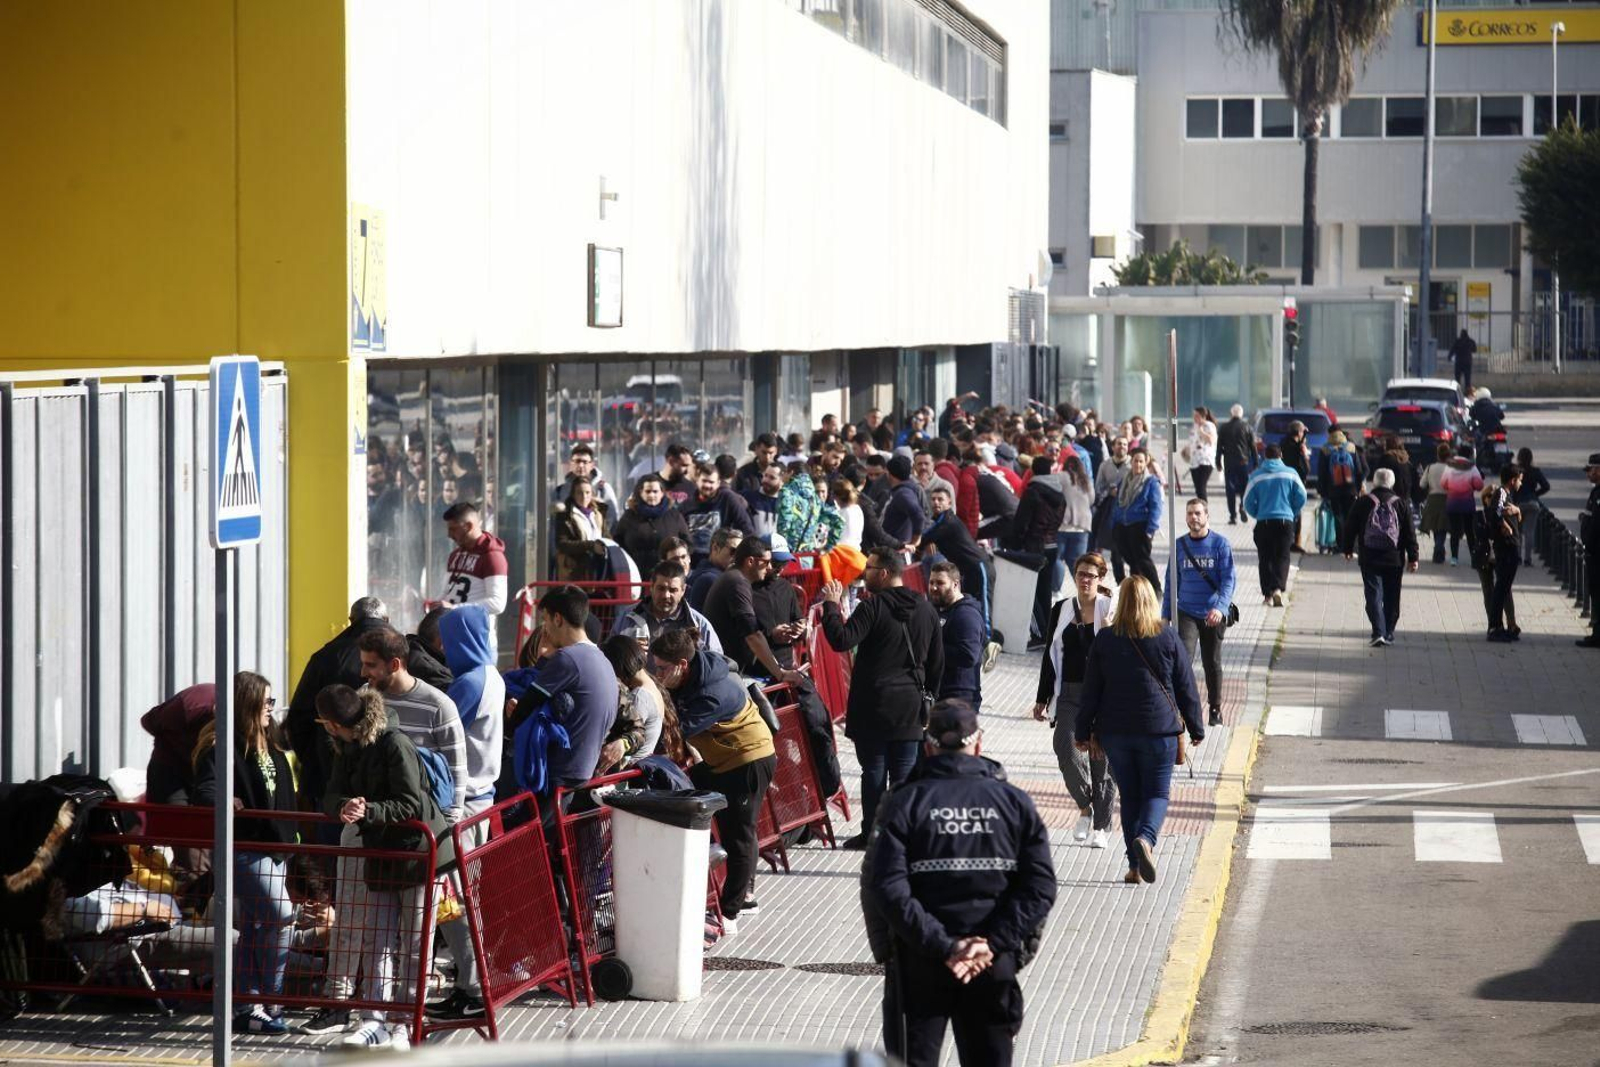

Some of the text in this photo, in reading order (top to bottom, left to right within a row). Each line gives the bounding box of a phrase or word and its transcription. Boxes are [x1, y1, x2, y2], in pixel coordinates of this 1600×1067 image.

[1468, 20, 1538, 37] CORREOS
[929, 807, 1000, 821] POLICIA
[937, 821, 994, 835] LOCAL
